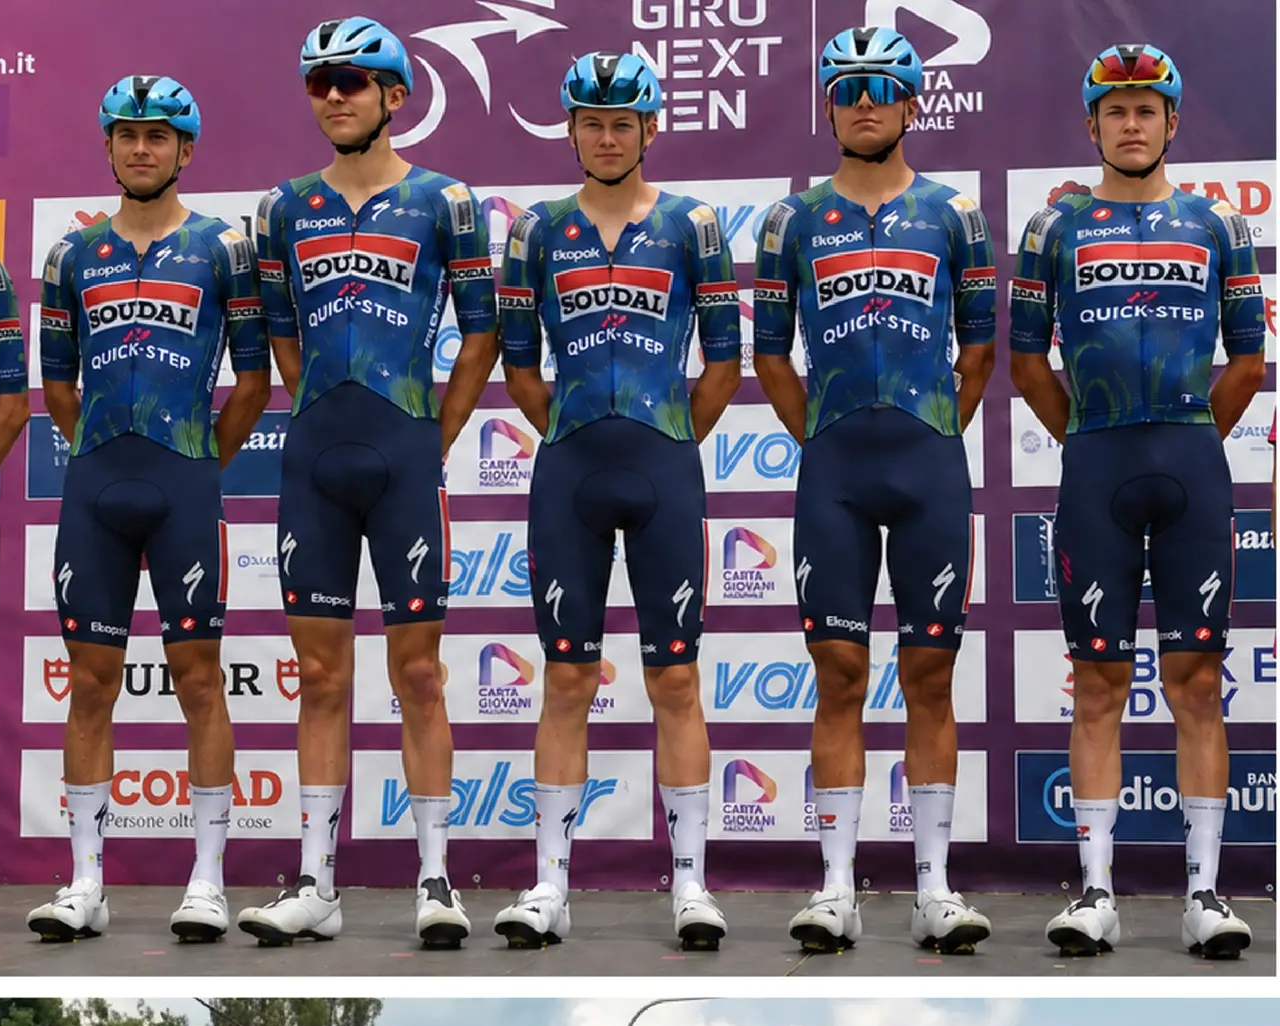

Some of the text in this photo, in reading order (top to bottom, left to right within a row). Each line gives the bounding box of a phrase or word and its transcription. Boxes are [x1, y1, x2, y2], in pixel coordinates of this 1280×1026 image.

[631, 0, 768, 30] GIRO
[631, 36, 783, 80] NEXT
[916, 91, 983, 114] VANI
[301, 253, 412, 287] SOUDAL
[818, 265, 932, 304] SOUDAL
[1077, 261, 1205, 288] SOUDAL
[90, 300, 194, 331] SOUDAL
[561, 287, 666, 317] SOUDAL
[478, 698, 532, 709] GIOVANI
[105, 812, 164, 828] Persone
[237, 816, 272, 829] cose
